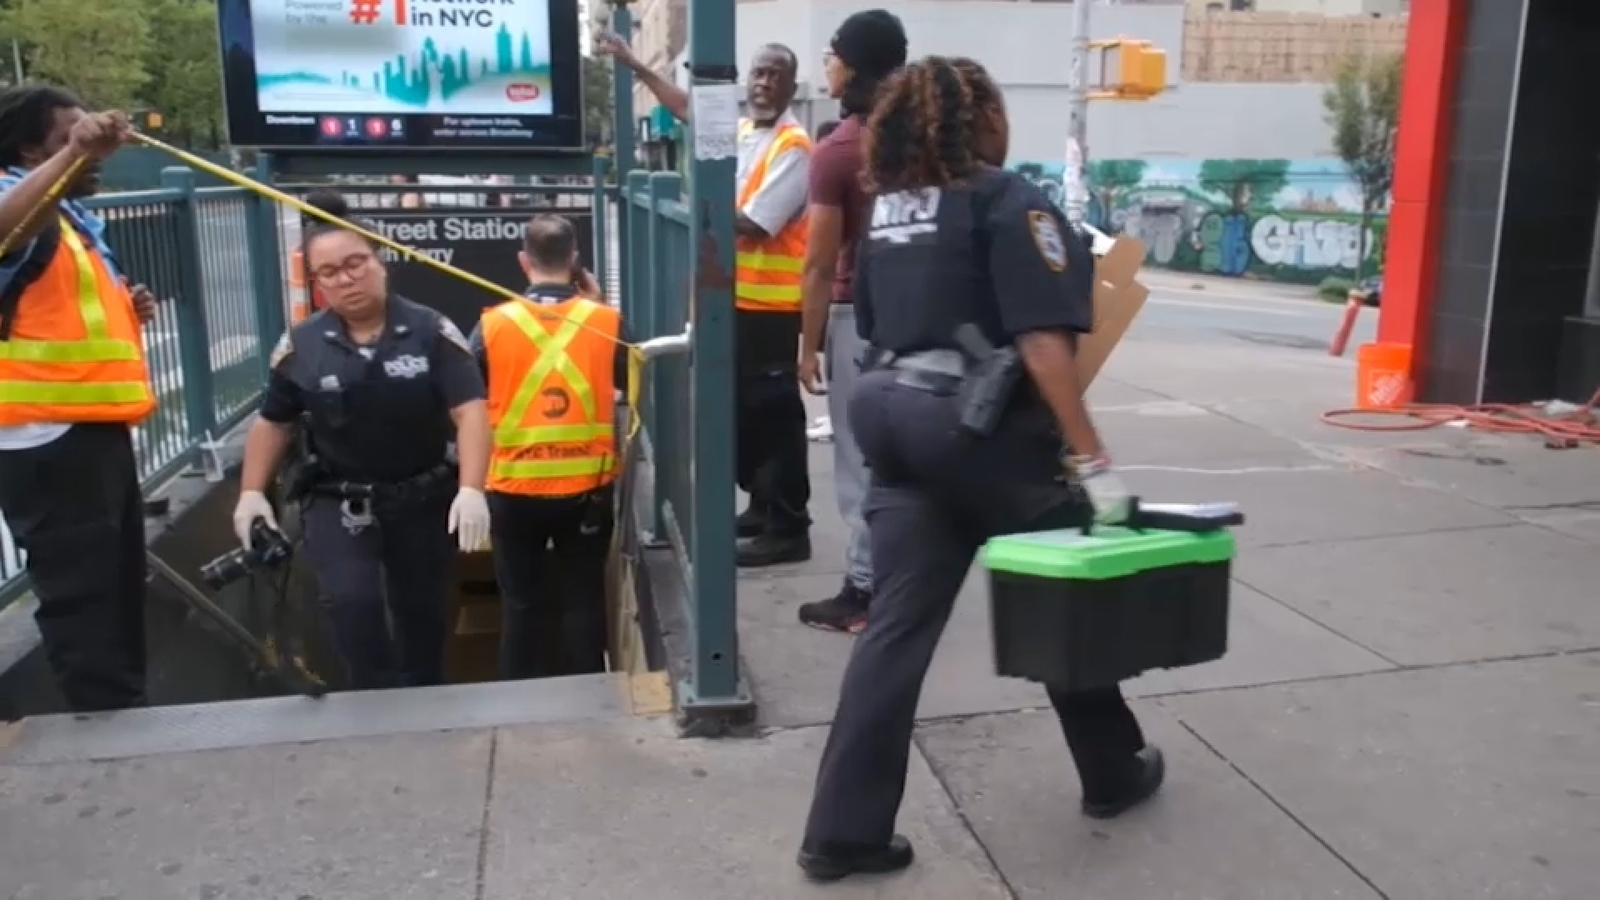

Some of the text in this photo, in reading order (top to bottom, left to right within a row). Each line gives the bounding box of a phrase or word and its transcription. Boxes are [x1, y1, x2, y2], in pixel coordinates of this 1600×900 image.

[411, 6, 493, 27] in NYC
[402, 245, 454, 265] Frry
